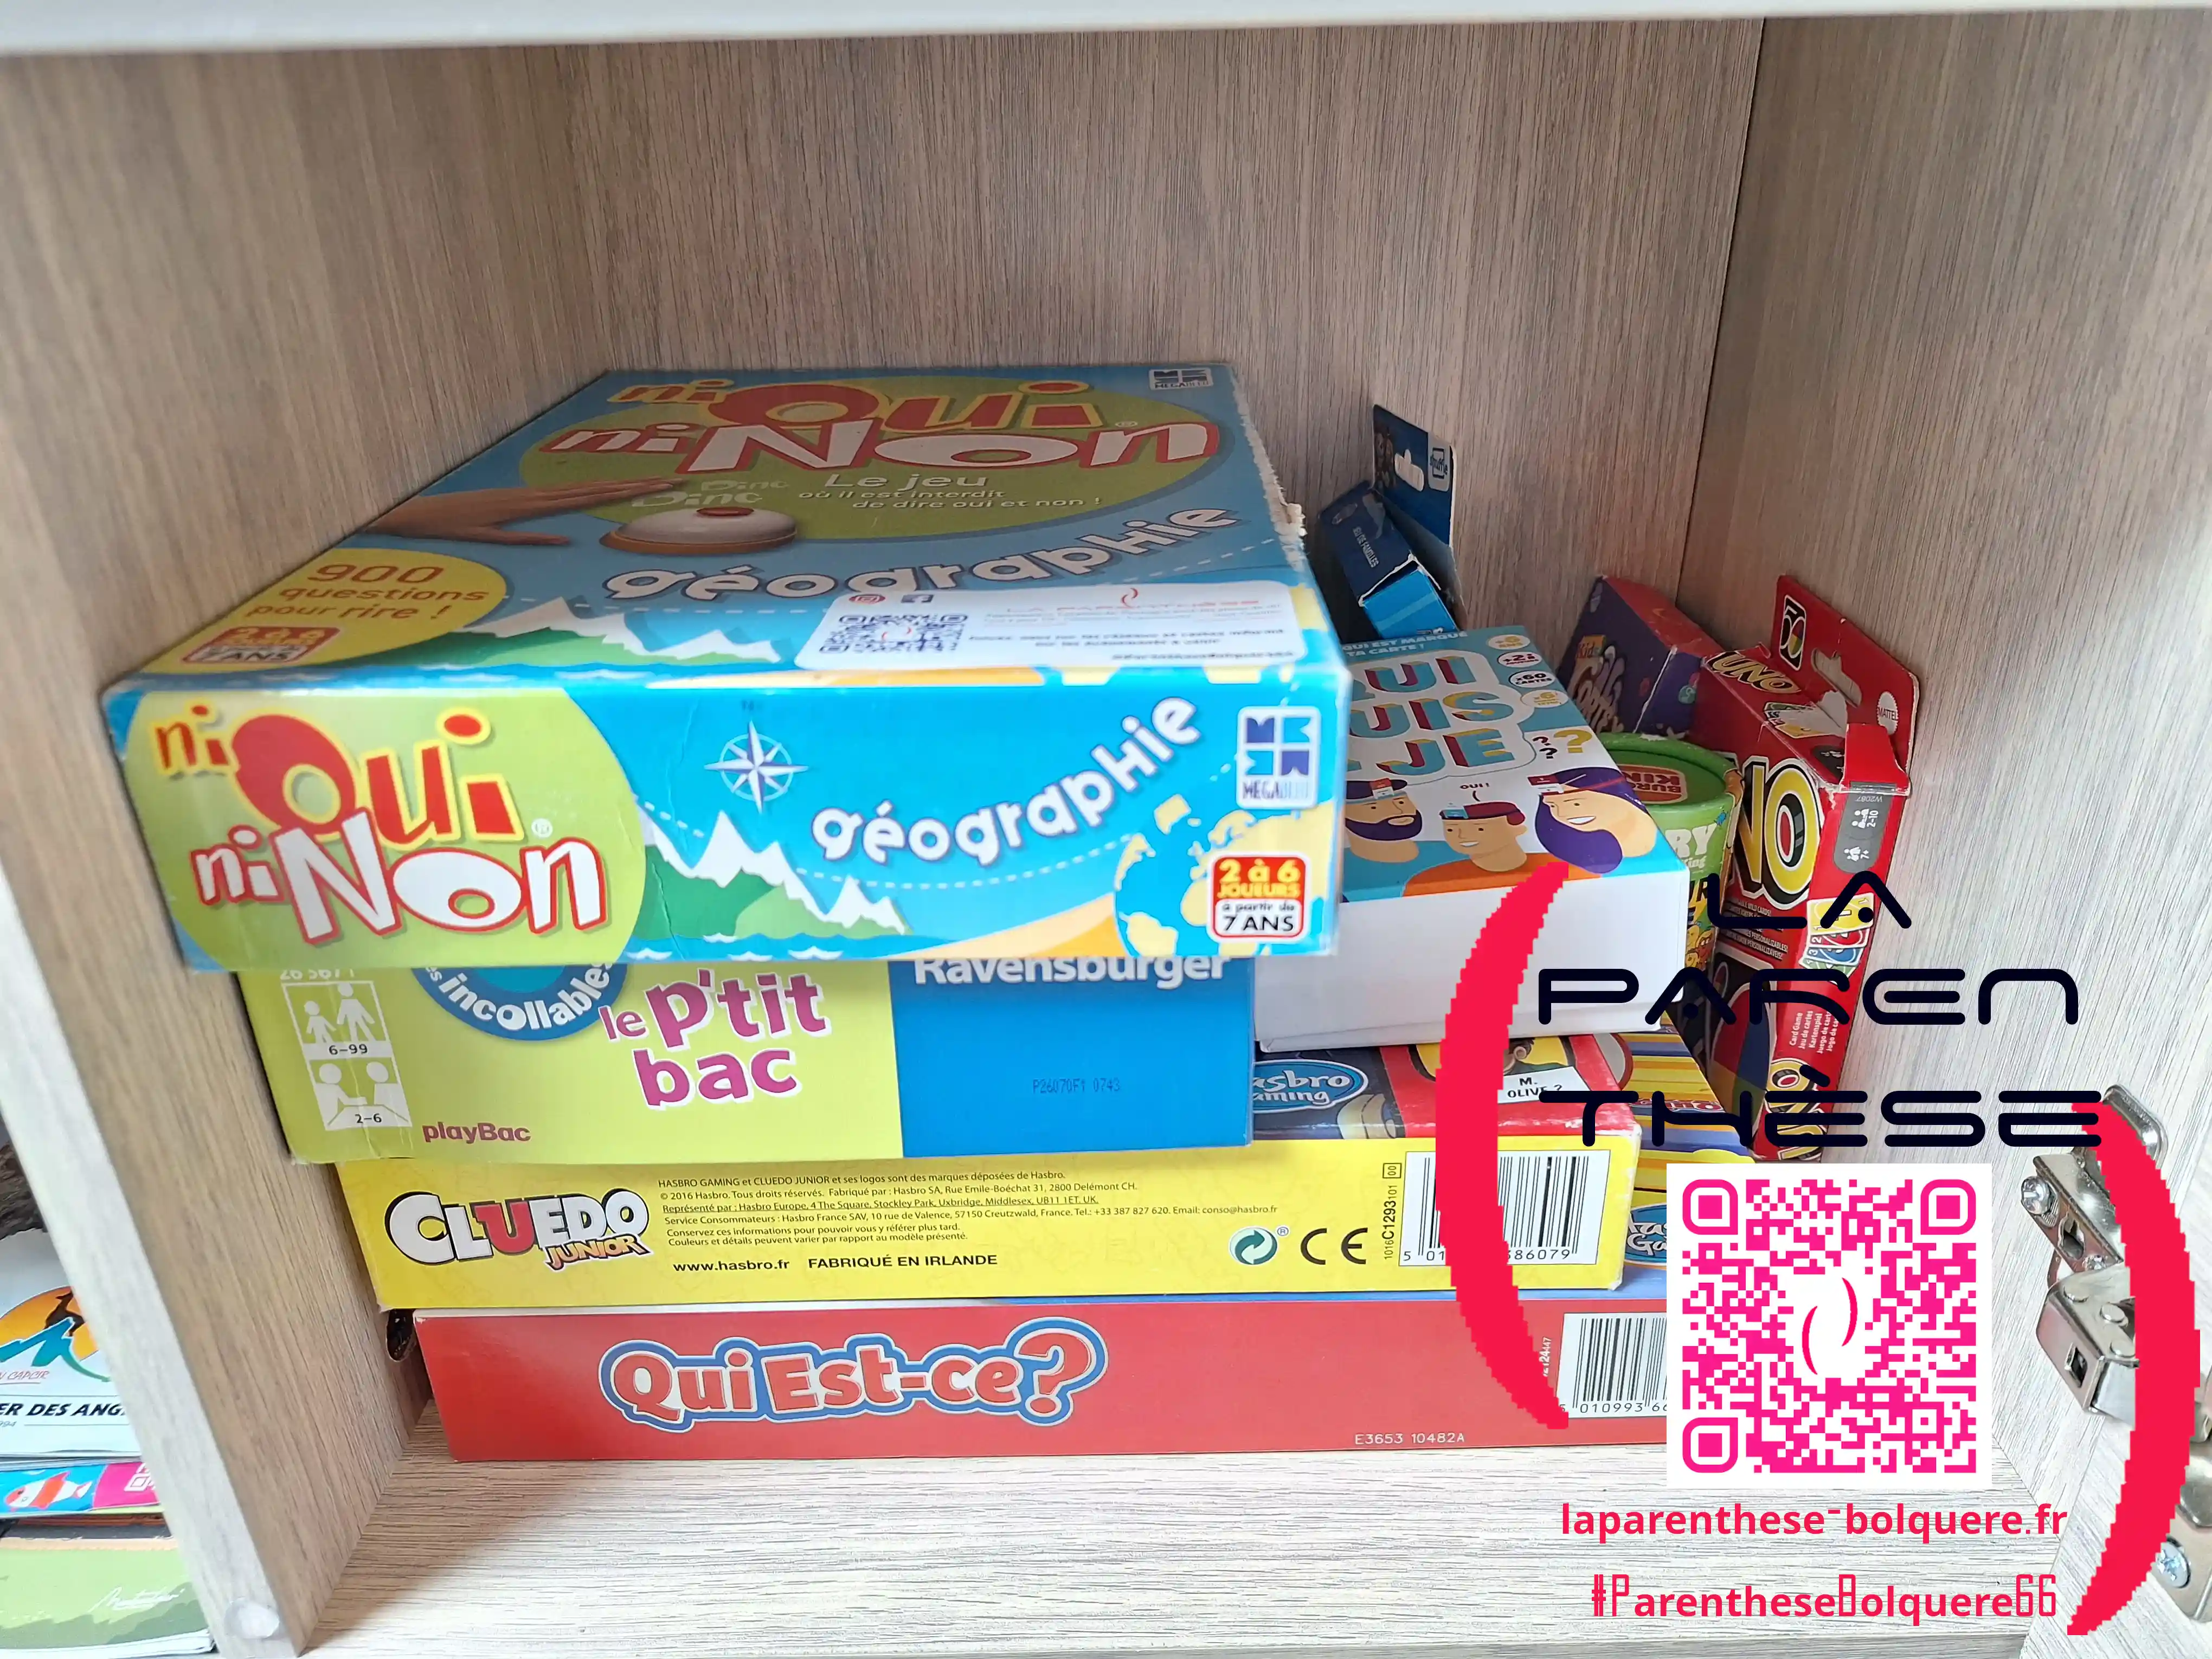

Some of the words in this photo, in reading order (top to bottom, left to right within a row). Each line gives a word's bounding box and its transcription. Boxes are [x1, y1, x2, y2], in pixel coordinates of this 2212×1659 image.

[608, 378, 733, 404] ni
[704, 380, 1105, 433] Oui
[540, 422, 695, 453] ni
[675, 417, 1220, 474] Non
[825, 473, 889, 487] Le
[897, 473, 987, 492] jeu
[852, 500, 884, 508] de
[893, 500, 944, 508] dire
[1036, 499, 1084, 507] non
[910, 490, 1005, 498] interdit
[307, 564, 444, 584] 900
[278, 584, 491, 603] questions
[245, 606, 336, 618] pour
[340, 602, 420, 619] rire
[1368, 646, 1416, 654] CARTE
[1704, 651, 1802, 694] UNO
[1350, 691, 1514, 739] UIS
[1877, 706, 1898, 721] MATTEL
[150, 698, 237, 774] ni
[230, 706, 524, 850] Oui
[1867, 810, 1879, 828] 2-10
[190, 824, 284, 906] ni
[272, 807, 607, 946] Non
[1219, 859, 1241, 884] 2
[1248, 858, 1270, 884] à
[1277, 859, 1300, 884] 6
[1217, 880, 1301, 899] JOUEURS
[1224, 916, 1238, 930] 7
[1243, 916, 1294, 931] ANS
[914, 956, 1232, 990] Ravensburger
[599, 1006, 648, 1041] le
[646, 968, 832, 1051] p'tit
[1792, 1012, 1803, 1031] Game
[1804, 1011, 1814, 1030] cartes
[1789, 1031, 1799, 1046] Card
[1808, 1013, 1823, 1049] Kartenspiel
[633, 1048, 802, 1110] bac
[1519, 1077, 1538, 1086] M.
[422, 1121, 531, 1143] playBac
[658, 1179, 698, 1187] HASBRO
[699, 1178, 740, 1187] GAMING
[754, 1177, 793, 1186] CLUEDO
[794, 1176, 830, 1185] JUNIOR
[860, 1174, 885, 1185] logos
[910, 1173, 926, 1182] des
[928, 1175, 969, 1184] marques
[970, 1172, 1015, 1182] déposées
[1031, 1171, 1065, 1180] Hasbro.
[670, 1192, 693, 1200] 2016
[695, 1190, 731, 1199] Hasbro.
[731, 1190, 754, 1198] Tous
[755, 1189, 782, 1198] droits
[784, 1188, 825, 1197] réservés.
[828, 1187, 869, 1198] Fabriqué
[893, 1186, 926, 1194] Hasbro
[928, 1186, 943, 1195] SA,
[964, 1184, 1031, 1193] Emile-Boéchat
[1033, 1184, 1046, 1193] 31,
[1049, 1183, 1071, 1191] 2800
[1073, 1182, 1119, 1191] Delémont
[1121, 1182, 1137, 1190] CH.
[663, 1203, 715, 1214] Représenté
[738, 1202, 771, 1210] Hasbro
[774, 1201, 809, 1211] Europe,
[818, 1200, 835, 1208] The
[837, 1200, 871, 1210] Square,
[873, 1199, 912, 1209] Stockley
[914, 1198, 937, 1207] Park,
[938, 1198, 983, 1207] Uxbridge,
[985, 1197, 1034, 1206] Middlesex,
[664, 1216, 698, 1224] Service
[700, 1214, 775, 1224] Consommateurs
[782, 1213, 815, 1221] Hasbro
[816, 1213, 847, 1221] France
[849, 1212, 869, 1221] SAV,
[914, 1211, 953, 1220] Valence,
[985, 1209, 1038, 1219] Creutzwald,
[1074, 1207, 1092, 1216] Tel.:
[1094, 1207, 1111, 1216] +33
[1133, 1207, 1149, 1215] 827
[1173, 1206, 1200, 1214] Email:
[1202, 1205, 1277, 1214] conso@hasbro.fr
[385, 1188, 650, 1265] CLUEDO
[666, 1228, 715, 1236] Conservez
[733, 1226, 792, 1235] informations
[818, 1225, 853, 1235] pouvoir
[918, 1224, 937, 1233] plus
[668, 1237, 709, 1246] Couleurs
[754, 1237, 793, 1245] peuvent
[839, 1235, 874, 1244] rapport
[889, 1233, 924, 1242] modèle
[926, 1232, 968, 1242] présenté.
[544, 1234, 652, 1272] JUNIOR
[673, 1259, 790, 1272] www.hasbro.fr
[808, 1254, 892, 1269] FABRIQUÉ
[897, 1257, 919, 1266] EN
[924, 1255, 998, 1266] IRLANDE
[8, 1371, 50, 1380] CAPCIR
[612, 1350, 755, 1423] Qui
[26, 1403, 73, 1416] DES
[1355, 1433, 1404, 1445] E3653
[1411, 1432, 1465, 1444] 10482A
